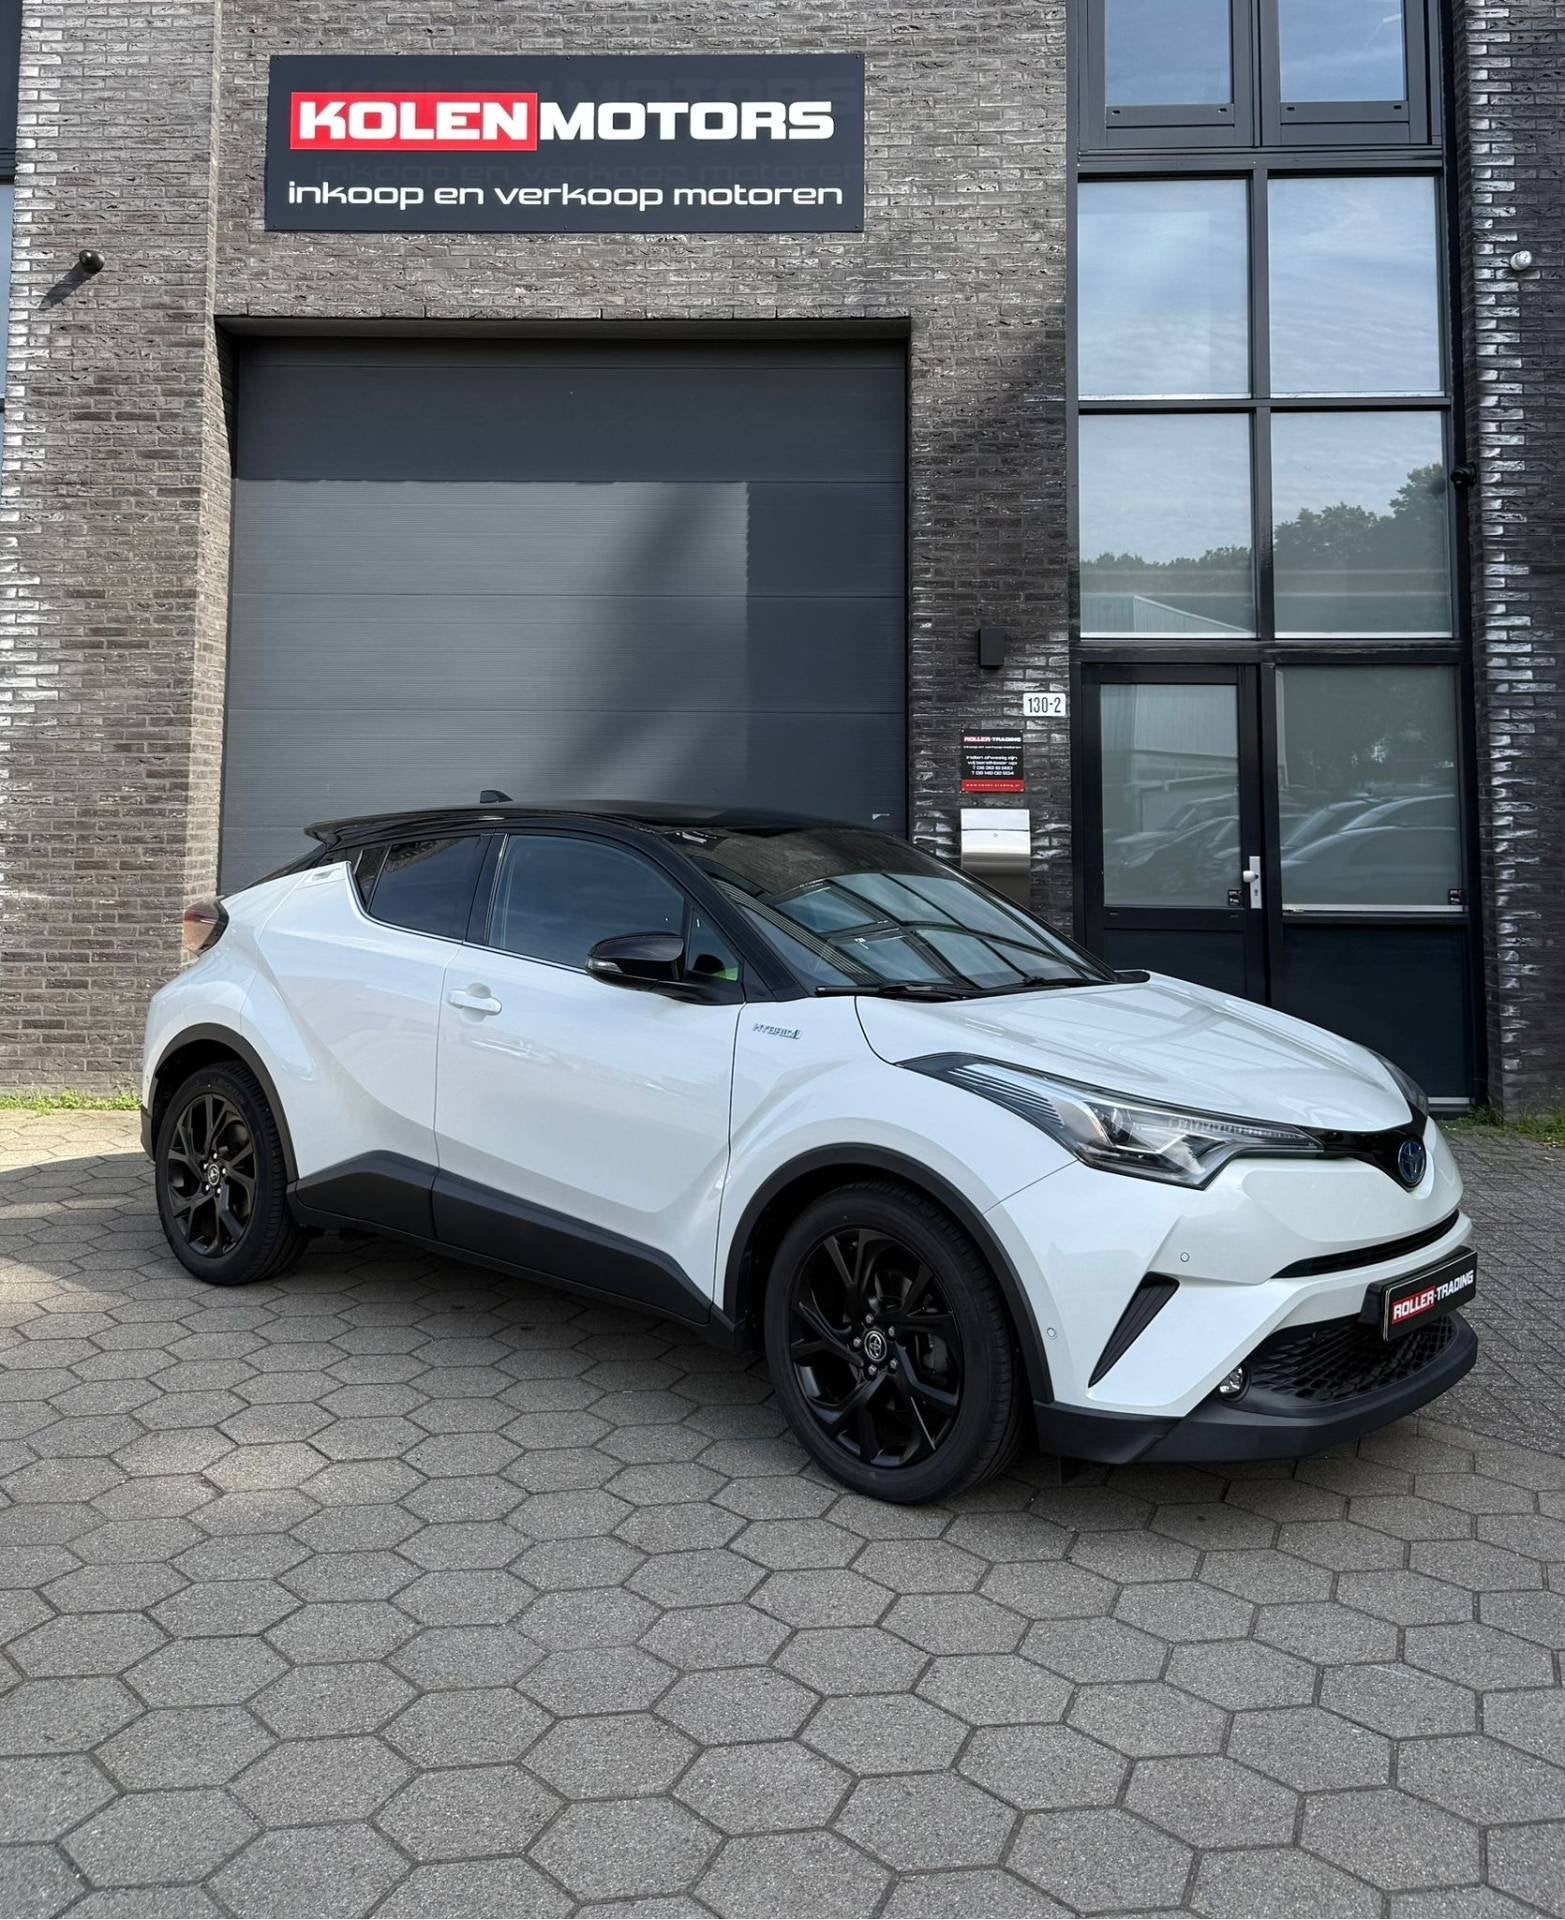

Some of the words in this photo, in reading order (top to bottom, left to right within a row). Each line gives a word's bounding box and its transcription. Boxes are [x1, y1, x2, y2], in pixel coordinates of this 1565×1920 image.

[298, 101, 528, 141] KOLEN
[539, 100, 835, 141] MOTORS
[288, 181, 424, 211] inkoop
[434, 186, 485, 206] en
[494, 182, 663, 212] verkoop
[673, 186, 843, 206] motoren
[1028, 696, 1061, 714] 130-2
